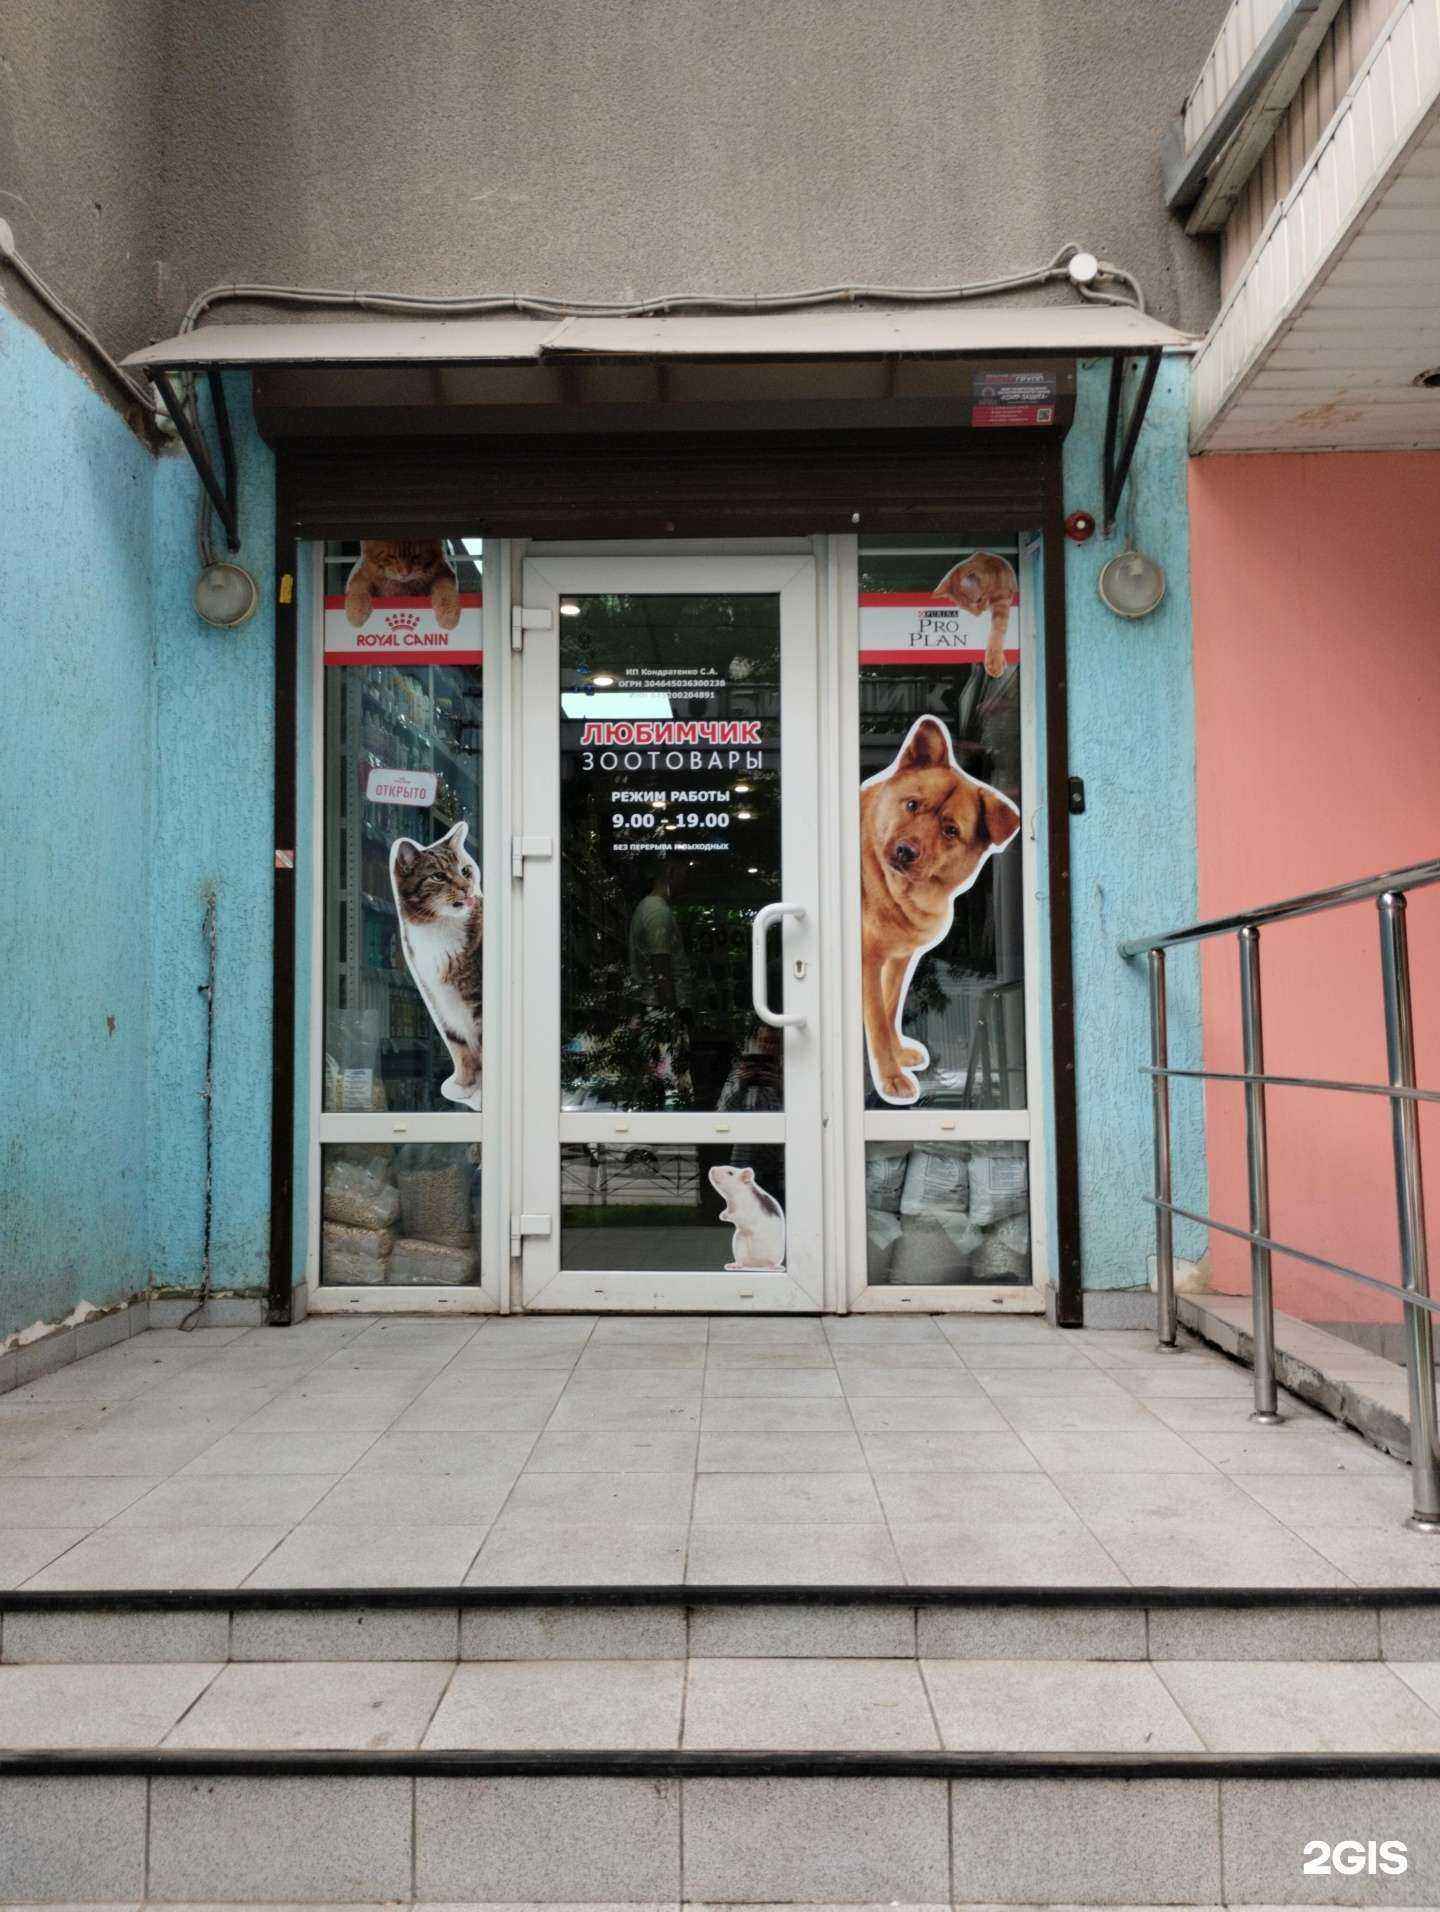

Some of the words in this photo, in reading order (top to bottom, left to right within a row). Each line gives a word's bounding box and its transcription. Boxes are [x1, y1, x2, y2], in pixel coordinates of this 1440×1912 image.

[357, 634, 400, 646] ROYAL
[402, 634, 449, 646] CANIN
[910, 633, 968, 647] PLAN
[641, 668, 698, 676] Кондратенко
[580, 721, 762, 745] ЛЮБИМЧИК
[582, 751, 762, 770] ЗООТОВАРЫ
[375, 784, 427, 800] ОТКРЫТО
[611, 791, 666, 802] РЕЖИМ
[670, 791, 730, 802] РАБОТЫ
[612, 813, 655, 828] 9.00
[675, 813, 730, 828] 19.00
[629, 843, 672, 851] ПЕРЕРЫВА
